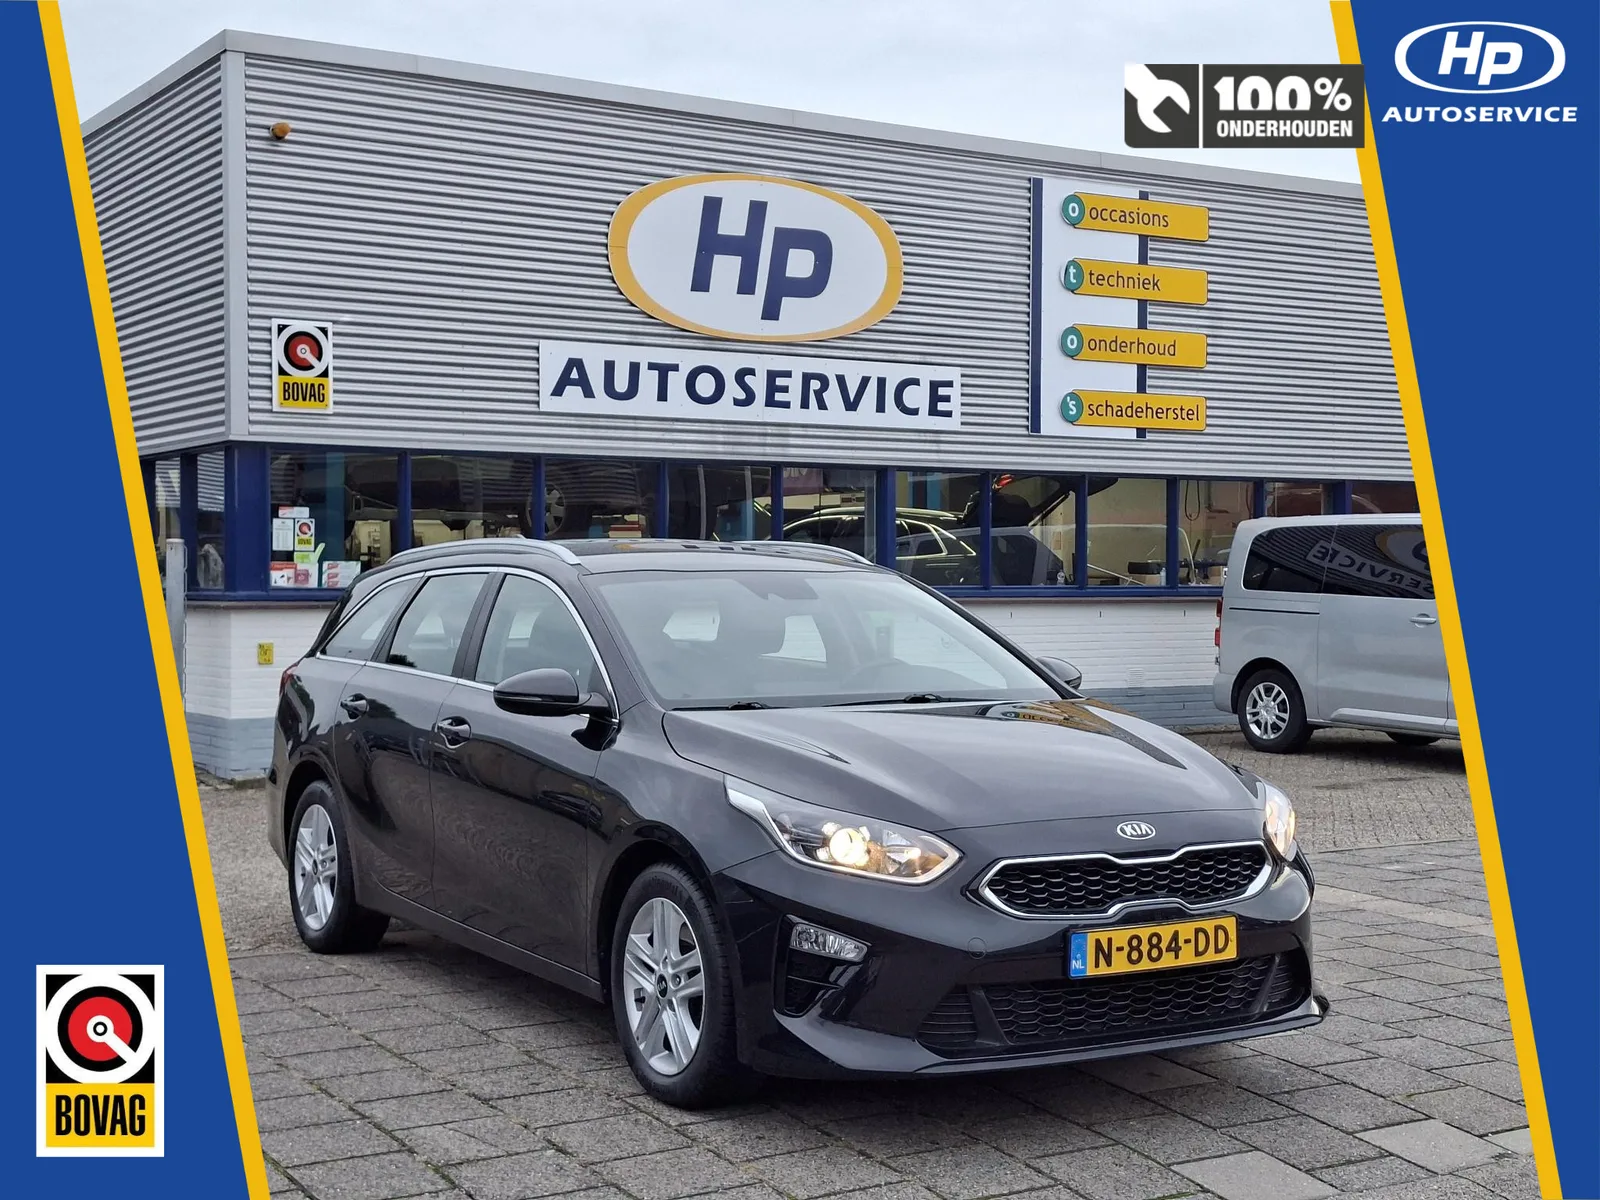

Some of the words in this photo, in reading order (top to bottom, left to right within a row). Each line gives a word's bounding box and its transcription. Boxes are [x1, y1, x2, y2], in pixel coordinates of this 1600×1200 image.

[1089, 206, 1169, 228] occasions
[690, 195, 833, 321] Hp
[1089, 269, 1161, 292] techniek
[1087, 335, 1177, 357] onderhoud
[282, 381, 325, 403] BOVAG
[550, 356, 955, 419] AUTOSERVICE
[1087, 400, 1200, 421] schadeherstel
[1122, 823, 1151, 836] KIA
[1094, 924, 1230, 969] N-884-DD
[1072, 959, 1085, 970] NL
